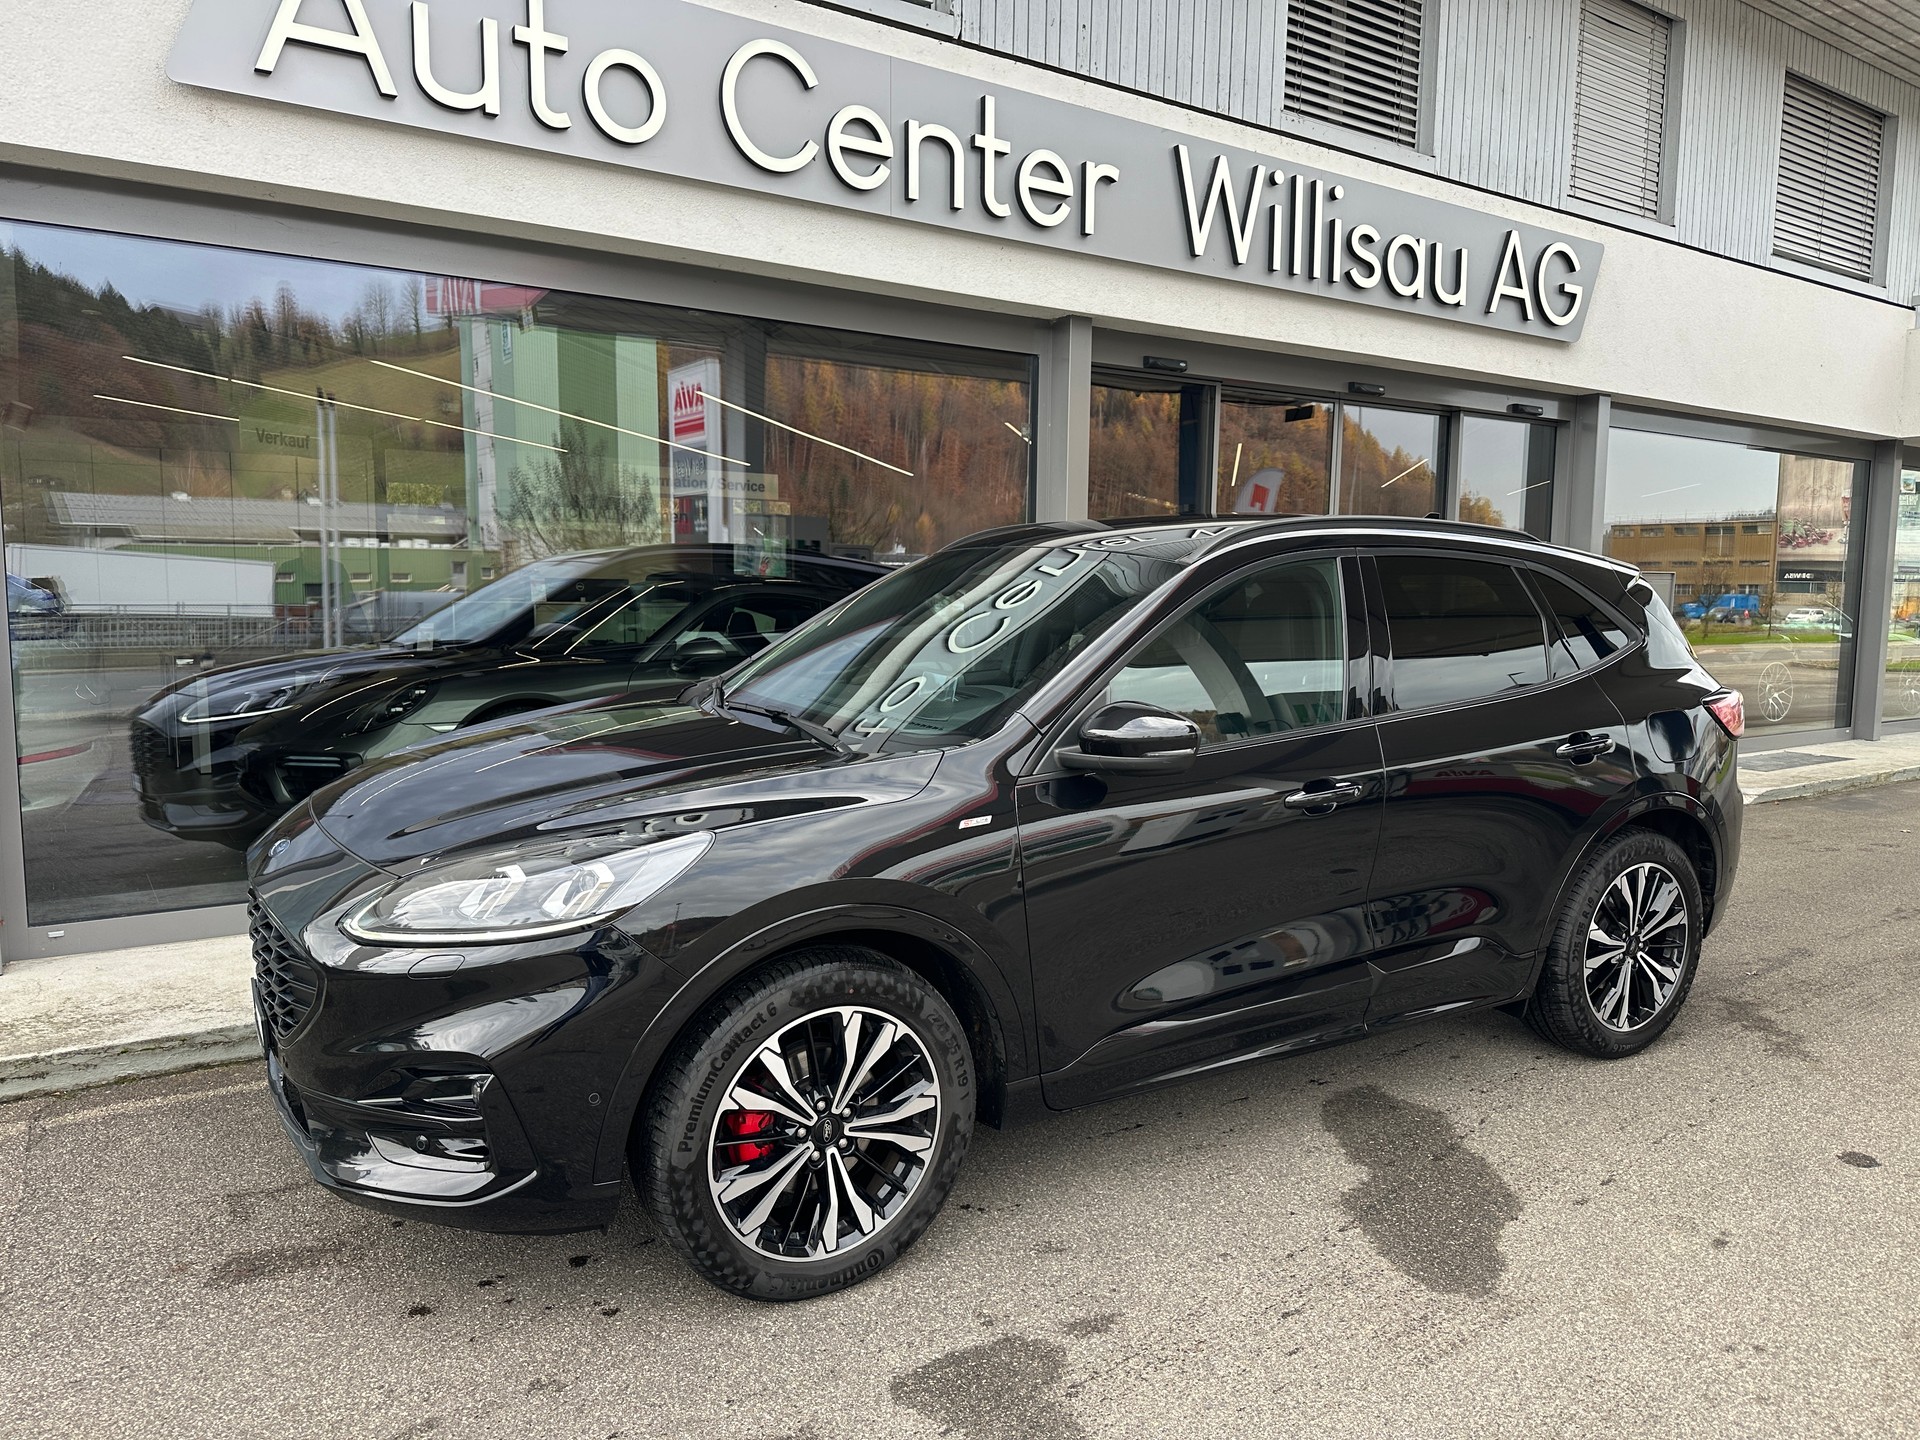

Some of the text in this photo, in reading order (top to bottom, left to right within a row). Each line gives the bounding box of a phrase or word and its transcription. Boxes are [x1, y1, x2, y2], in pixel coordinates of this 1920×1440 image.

[254, 0, 1584, 327] Auto Center Willisau AG
[255, 427, 310, 450] Verkauf
[717, 477, 766, 493] Service
[678, 1002, 778, 1152] PremiumContact 6
